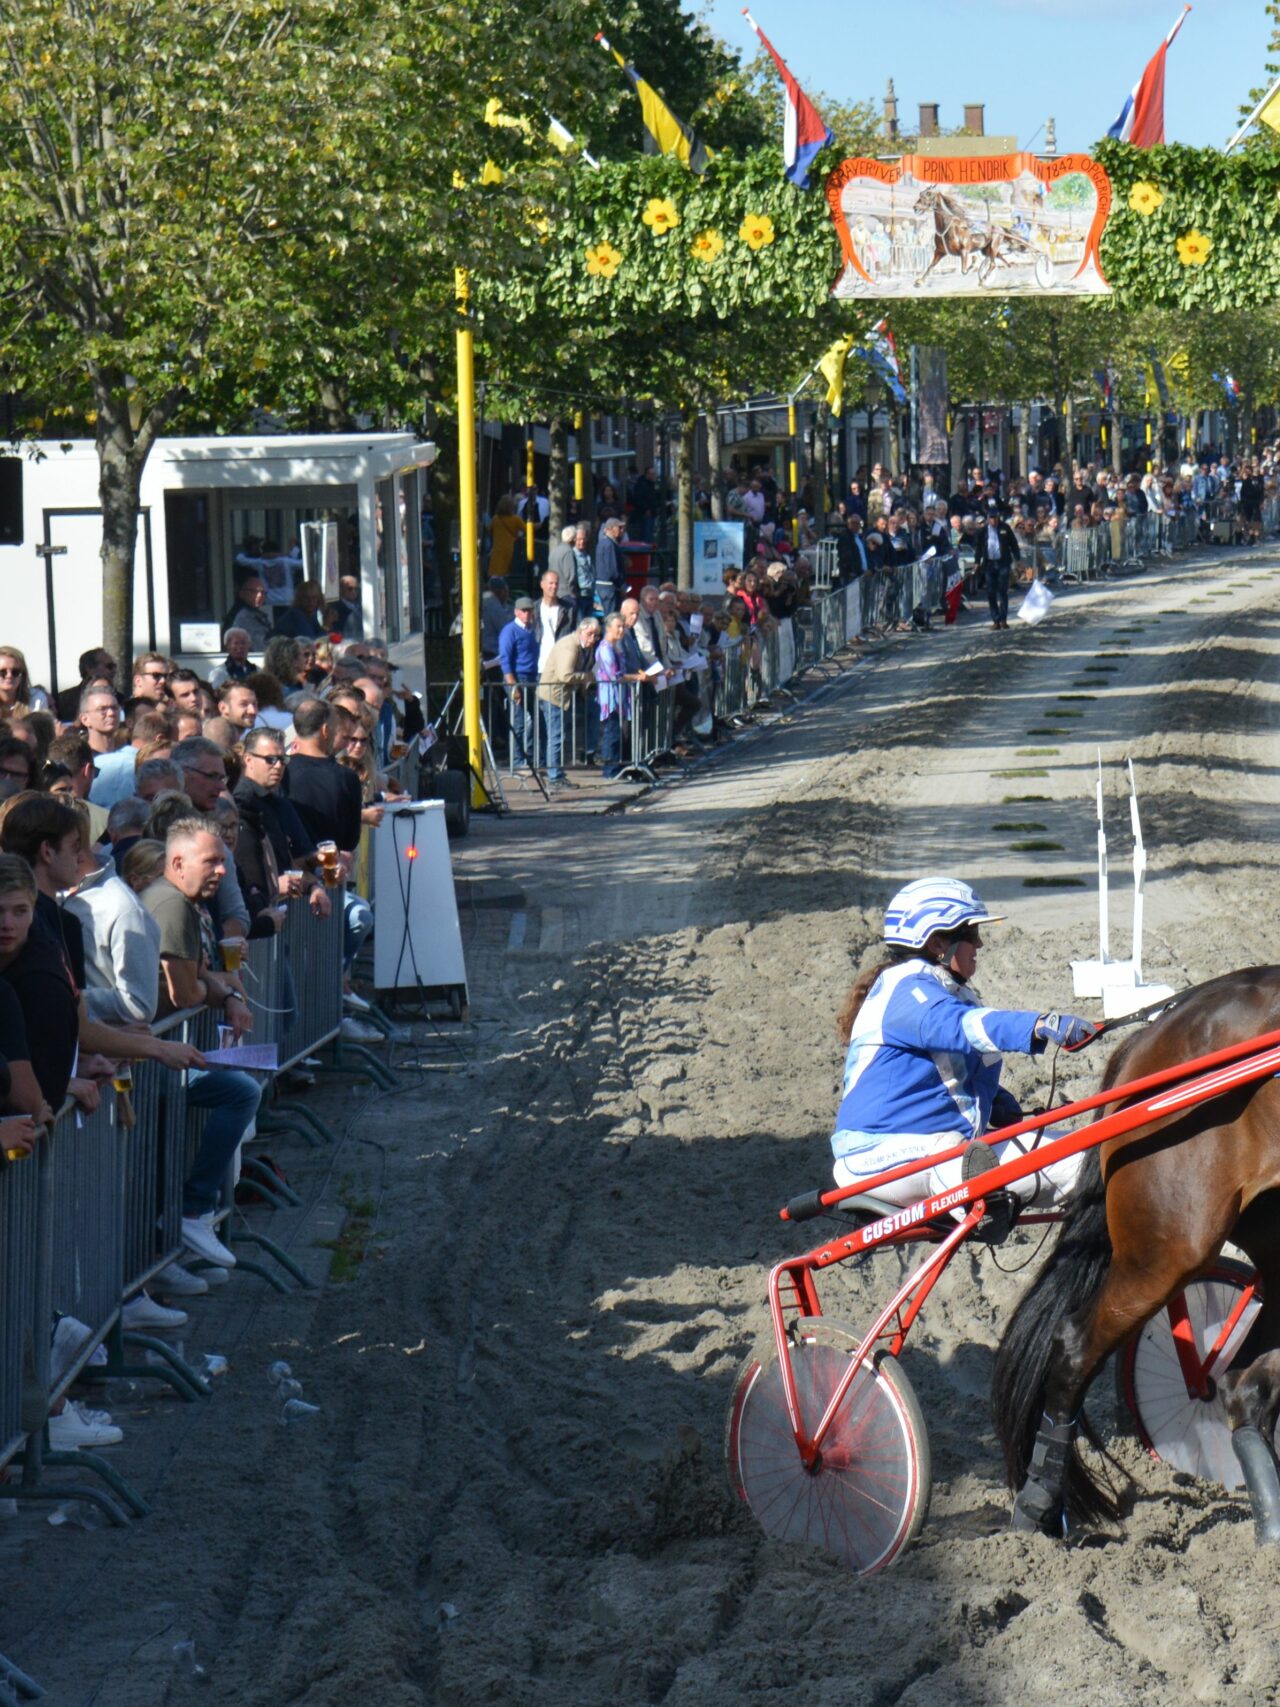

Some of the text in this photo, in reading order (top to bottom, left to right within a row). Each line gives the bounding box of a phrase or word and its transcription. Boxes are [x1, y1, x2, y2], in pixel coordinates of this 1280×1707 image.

[923, 160, 954, 183] PRINS
[959, 159, 1011, 182] HENDRIK
[1046, 157, 1074, 180] 1842
[1080, 158, 1107, 217] OPGERICHT
[861, 1187, 970, 1245] CUSTOM FLEXURE
